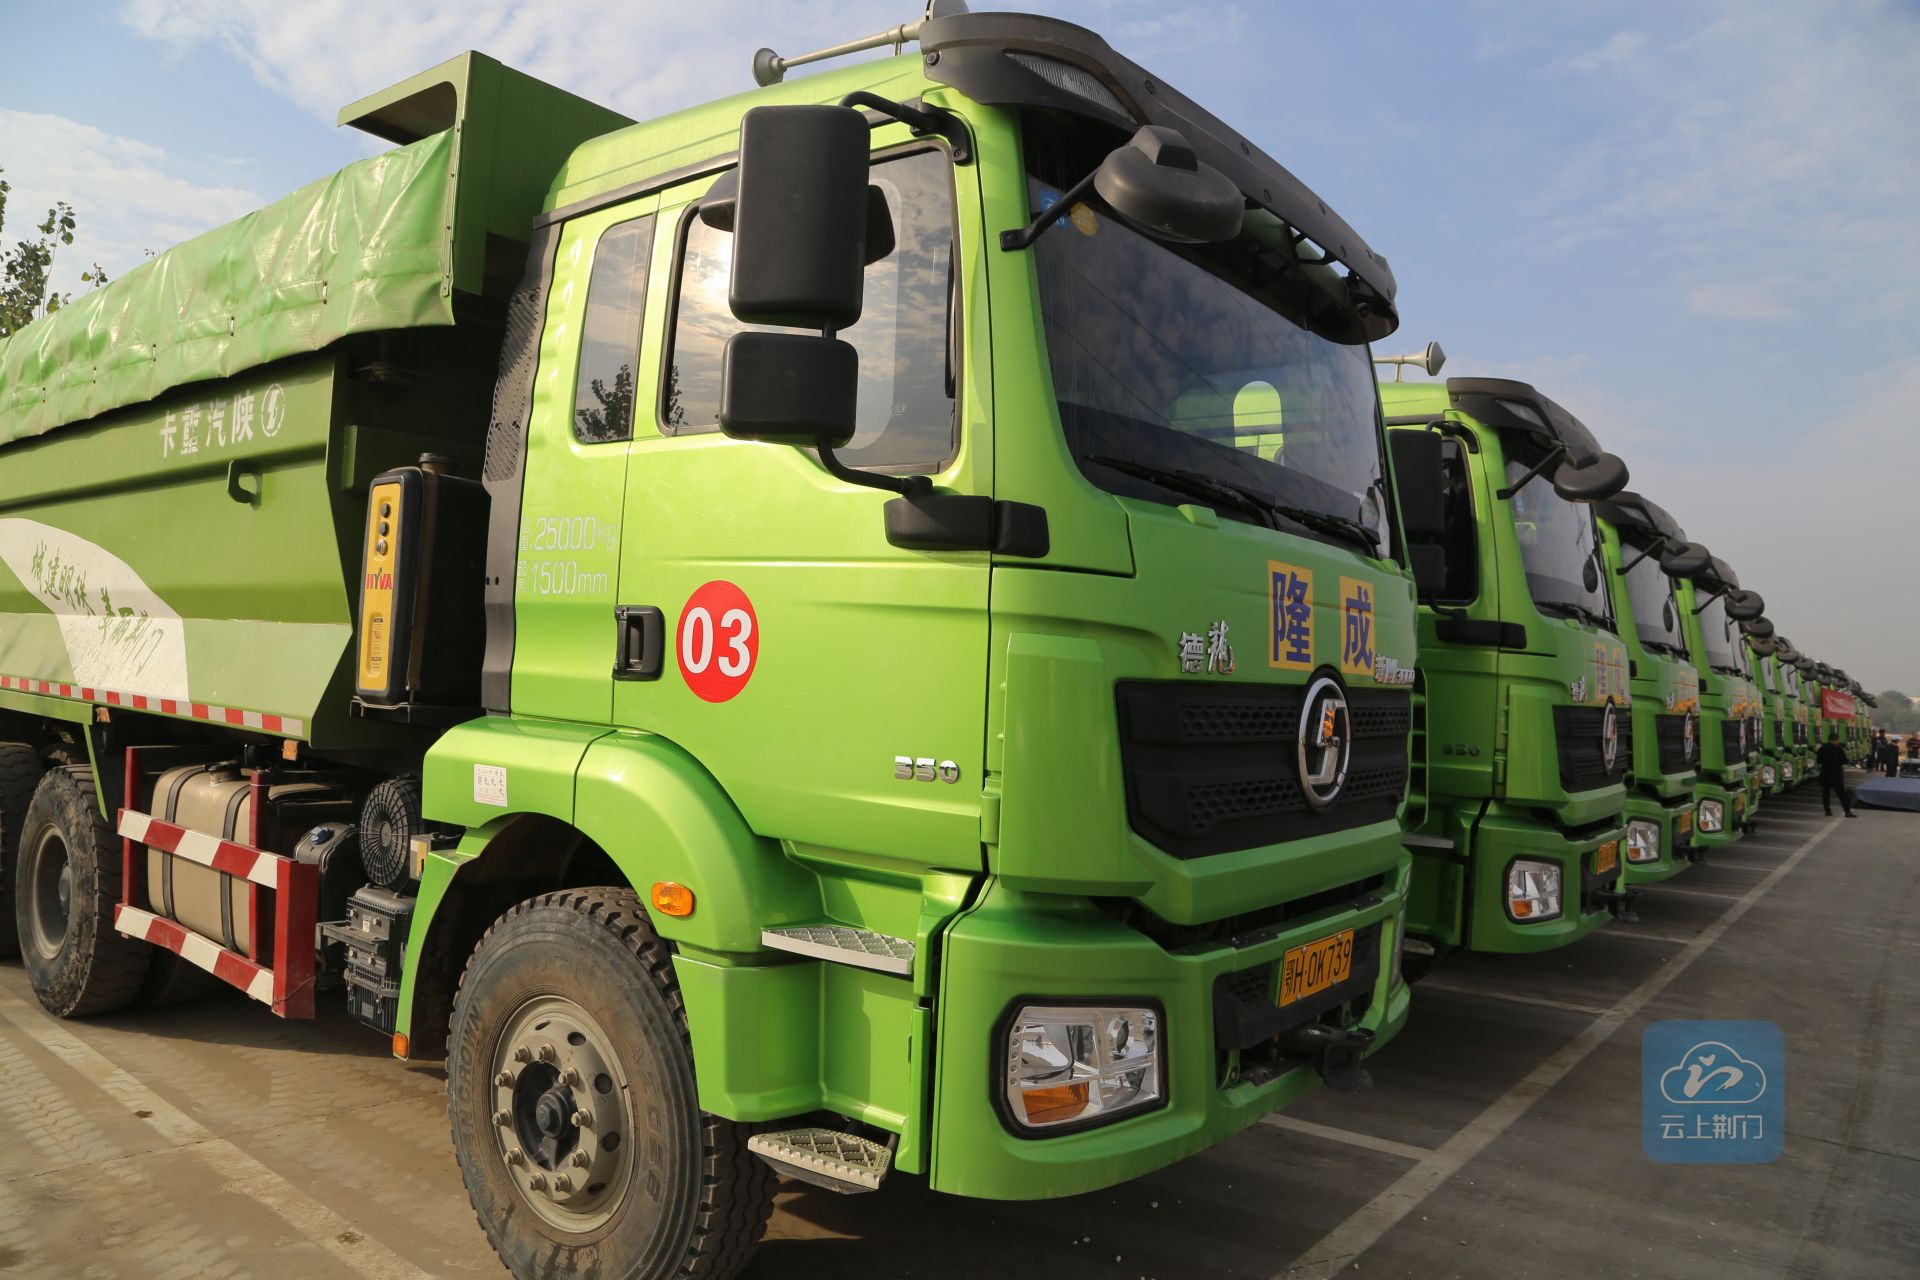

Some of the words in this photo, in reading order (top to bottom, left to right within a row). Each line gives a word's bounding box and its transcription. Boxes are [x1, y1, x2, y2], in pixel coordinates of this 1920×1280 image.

[366, 567, 393, 590] HYVA
[532, 560, 608, 595] 1500mm
[682, 606, 752, 678] 03
[895, 755, 959, 785] 350
